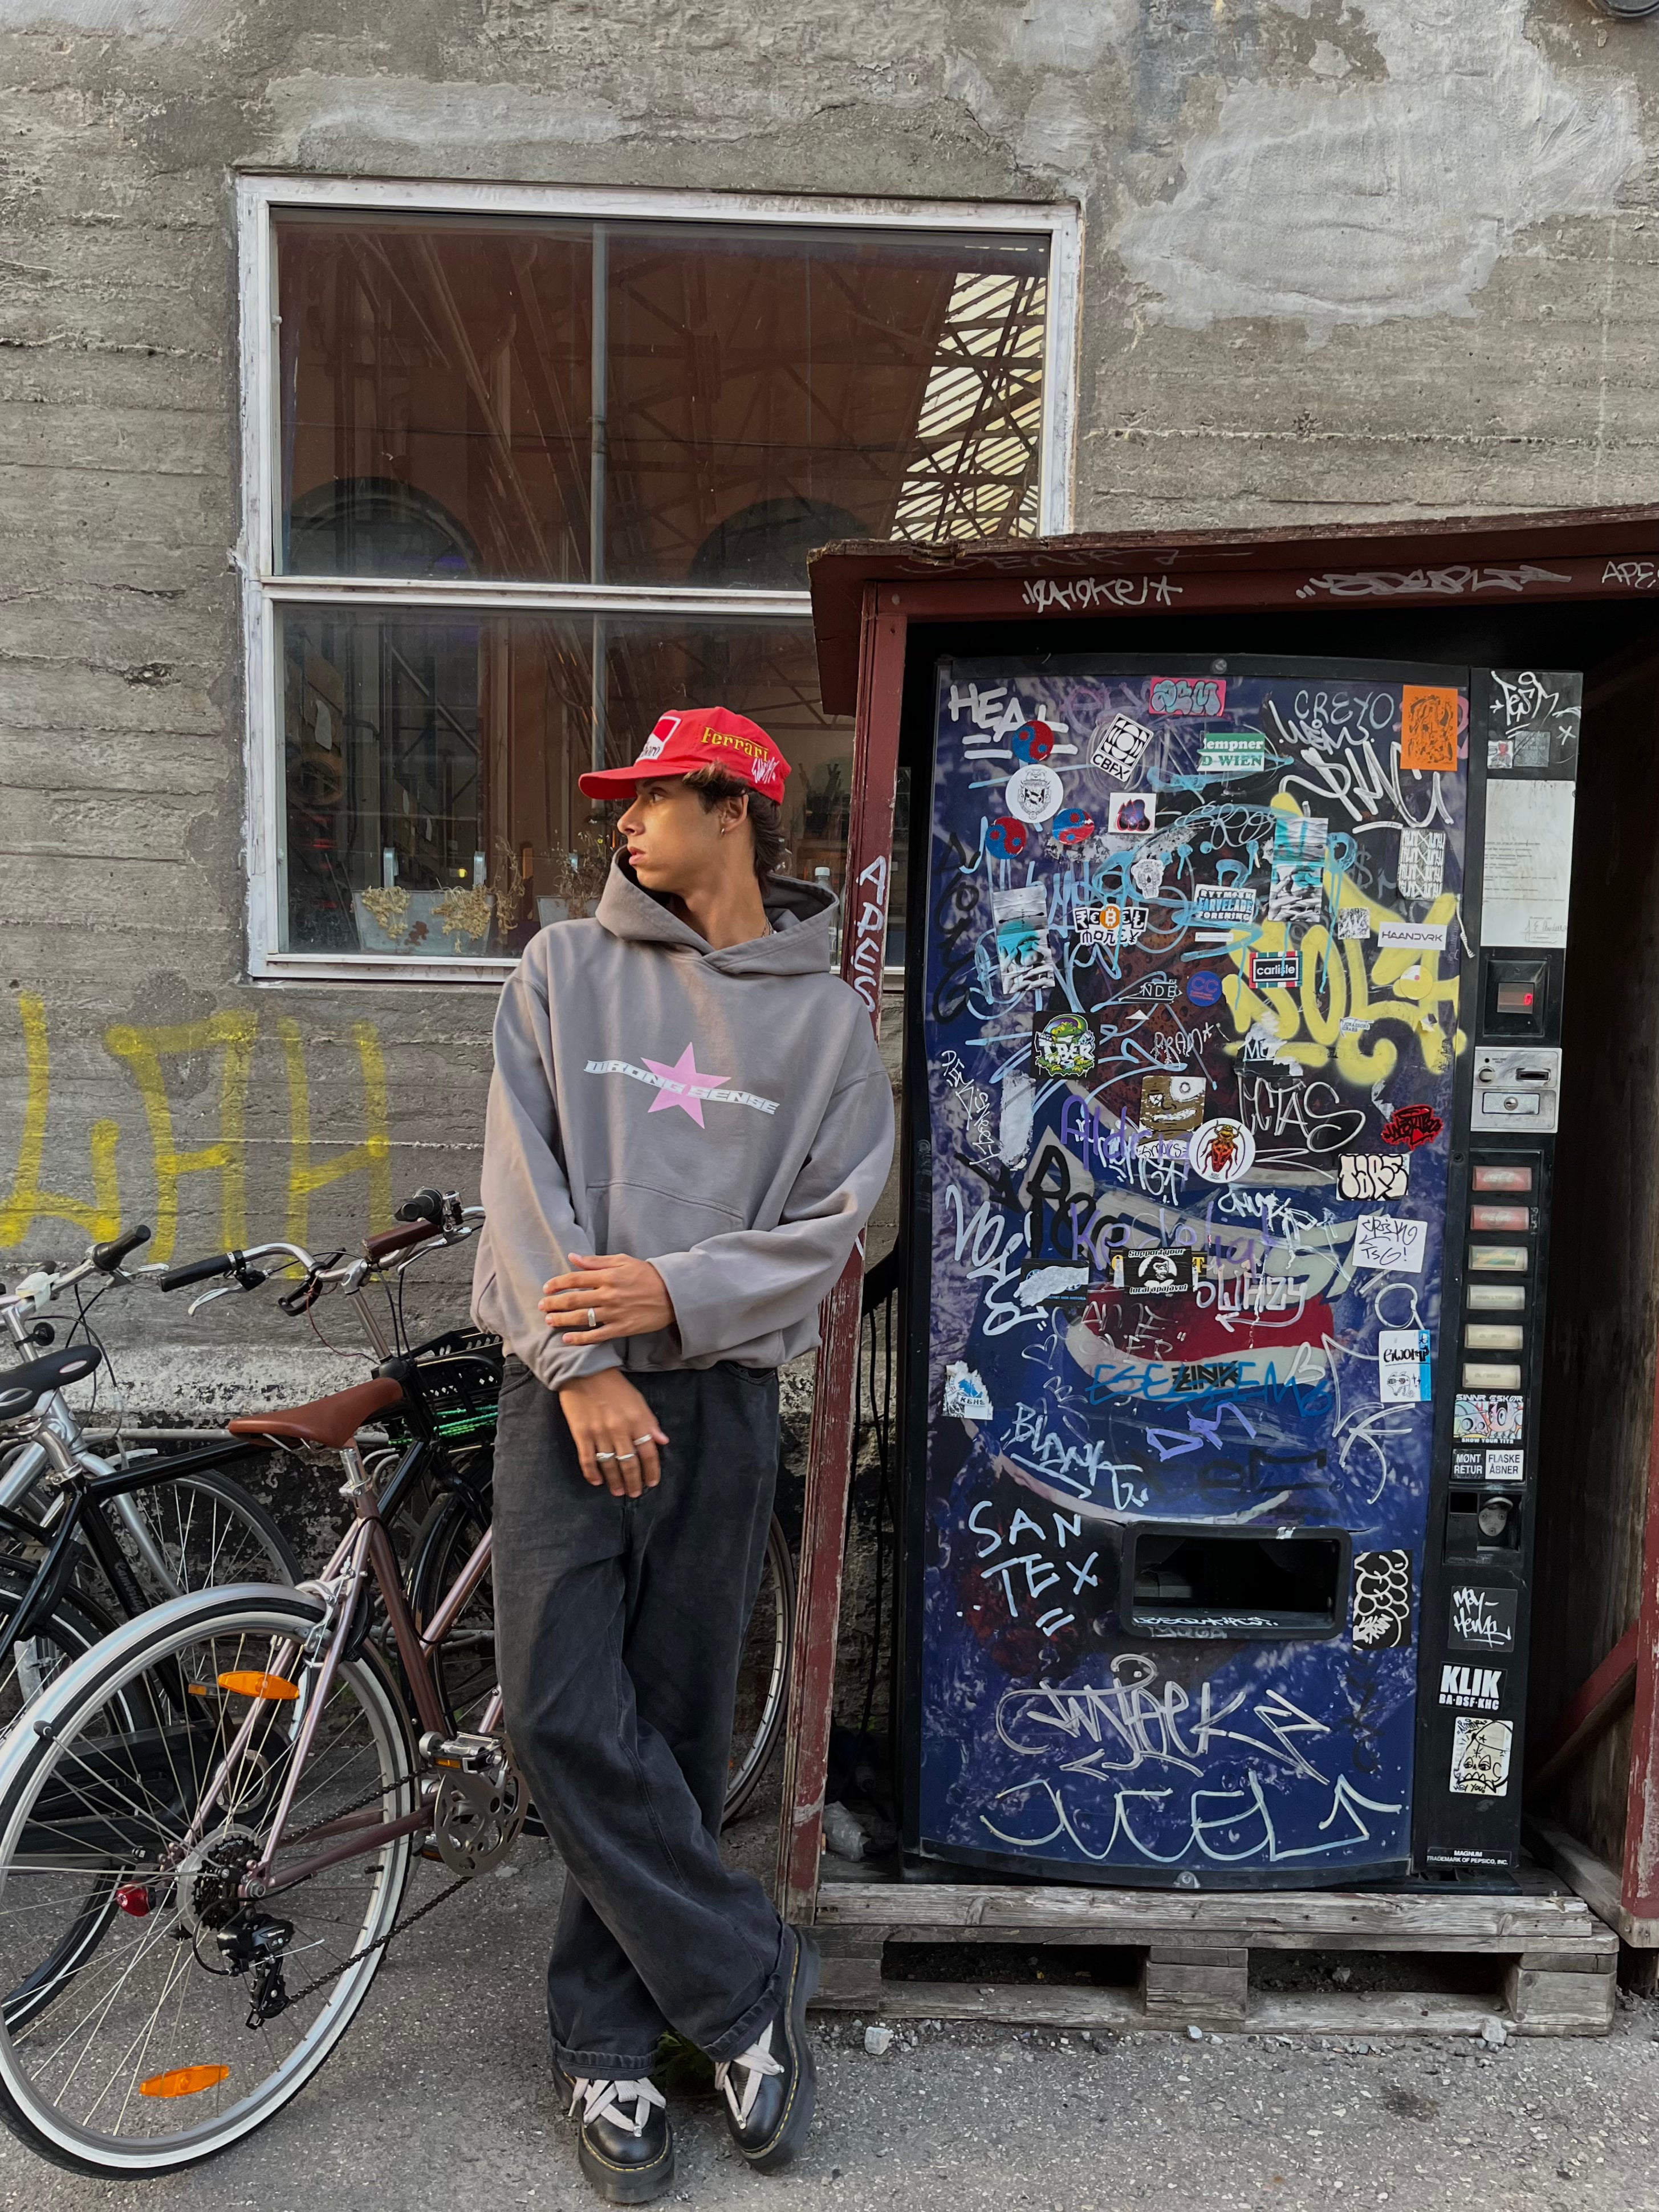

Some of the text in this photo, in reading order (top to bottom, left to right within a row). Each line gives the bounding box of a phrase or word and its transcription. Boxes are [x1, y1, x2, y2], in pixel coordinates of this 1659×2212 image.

[701, 726, 769, 762] Ferrari
[1202, 738, 1264, 752] lempner
[1218, 755, 1263, 766] WIEN
[1092, 753, 1130, 780] CBFX
[584, 1060, 780, 1115] WRONG SENSE
[1128, 1248, 1186, 1258] Support your
[1456, 1454, 1481, 1463] MØNT
[1489, 1454, 1520, 1463] FLASKE
[1454, 1465, 1483, 1474] RETUR
[1489, 1463, 1519, 1474] ÅBNER
[1440, 1665, 1502, 1699] KLIK
